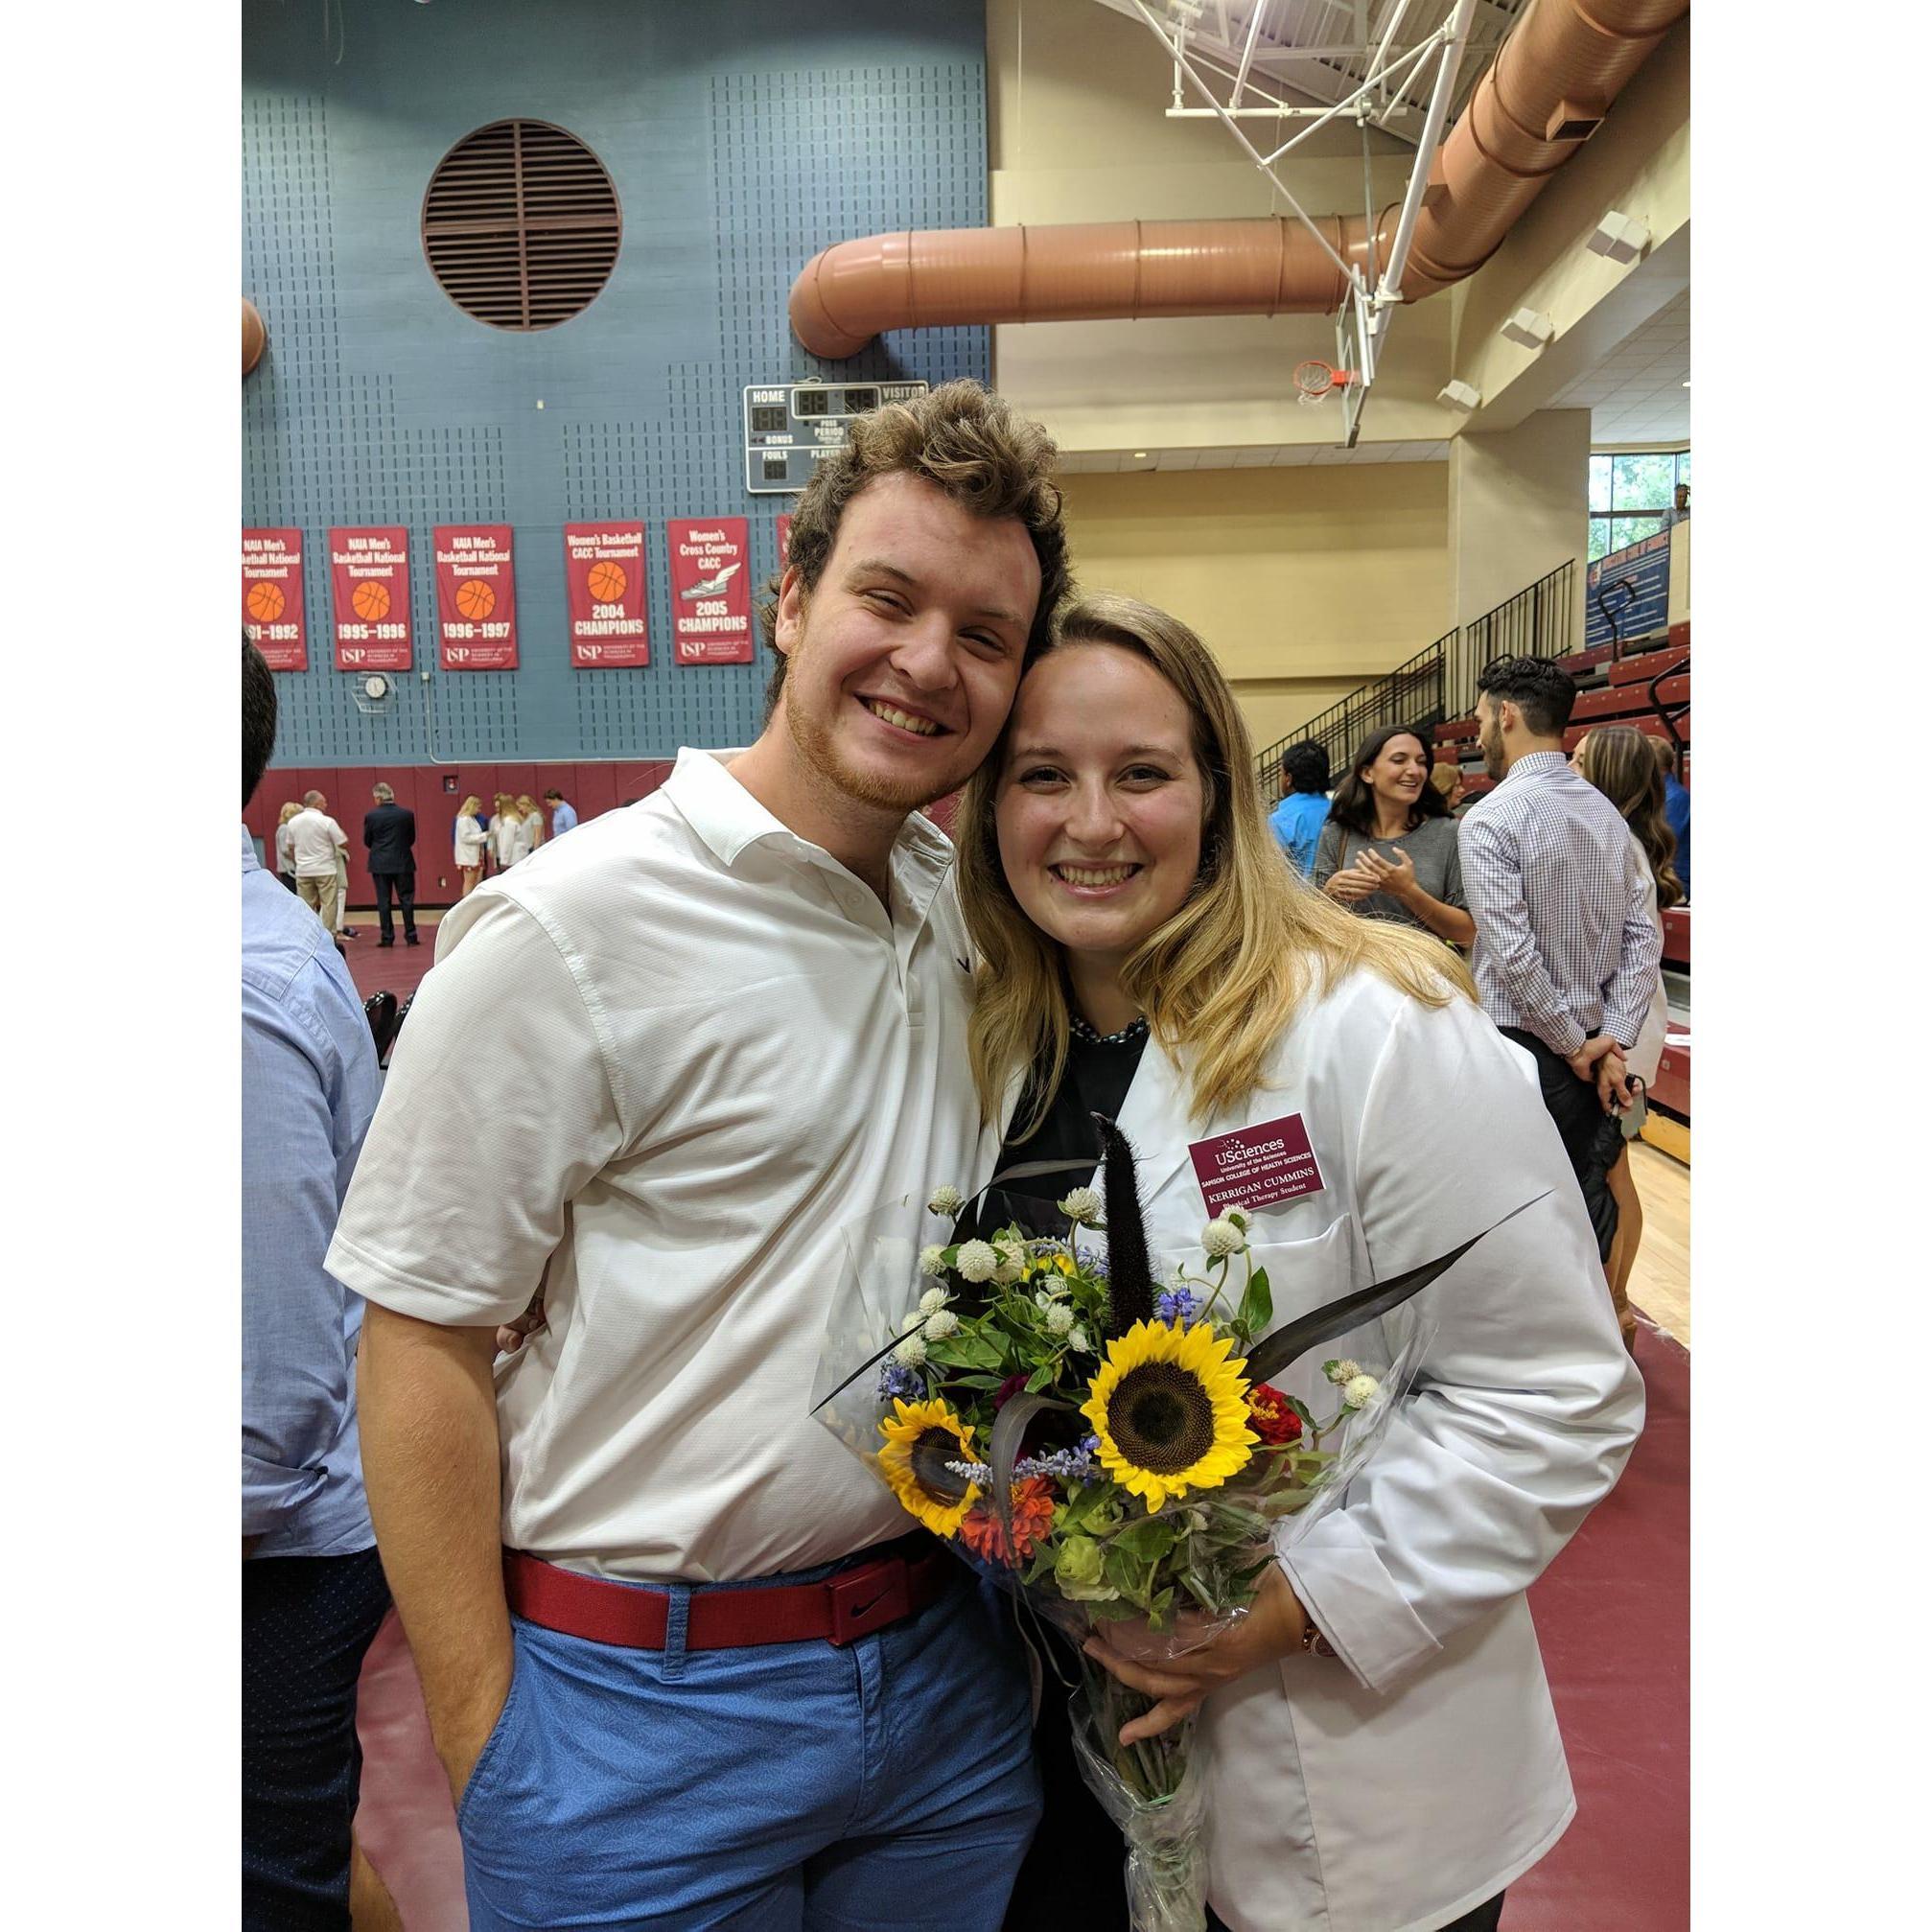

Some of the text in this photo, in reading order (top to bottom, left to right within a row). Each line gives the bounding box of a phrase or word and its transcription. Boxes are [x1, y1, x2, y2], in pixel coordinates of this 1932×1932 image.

[753, 390, 785, 403] HOME
[882, 385, 925, 399] VISITOR
[814, 427, 844, 437] PERIOD
[765, 434, 794, 445] BONUS
[762, 451, 788, 460] FOULS
[453, 537, 497, 549] NAIA Men's
[567, 532, 642, 547] Women's Basketball
[688, 529, 726, 543] Women's
[348, 538, 391, 550] NAIA Men's
[680, 542, 738, 556] Cross Country
[242, 552, 300, 565] ketball National
[333, 551, 406, 564] Basketball National
[436, 549, 511, 564] Basketball National
[571, 546, 639, 559] CACC Tournament
[452, 563, 500, 576] Tournament
[697, 556, 722, 570] CACC
[244, 566, 289, 578] Tournament
[348, 565, 393, 577] Tournament
[592, 603, 625, 619] 2004
[695, 600, 728, 617] 2005
[574, 618, 644, 636] CHAMPIONS
[678, 615, 748, 633] CHAMPIONS
[1215, 1138, 1285, 1166] USciences
[1220, 1162, 1246, 1174] University
[1263, 1151, 1287, 1161] Sciences
[1201, 1152, 1313, 1188] SAMSON COLLEGE OF HEALTH SCIENCES
[1208, 1167, 1315, 1204] KERRIGAN CUMMINS
[1251, 1191, 1278, 1202] Therapy
[1280, 1183, 1307, 1195] Student
